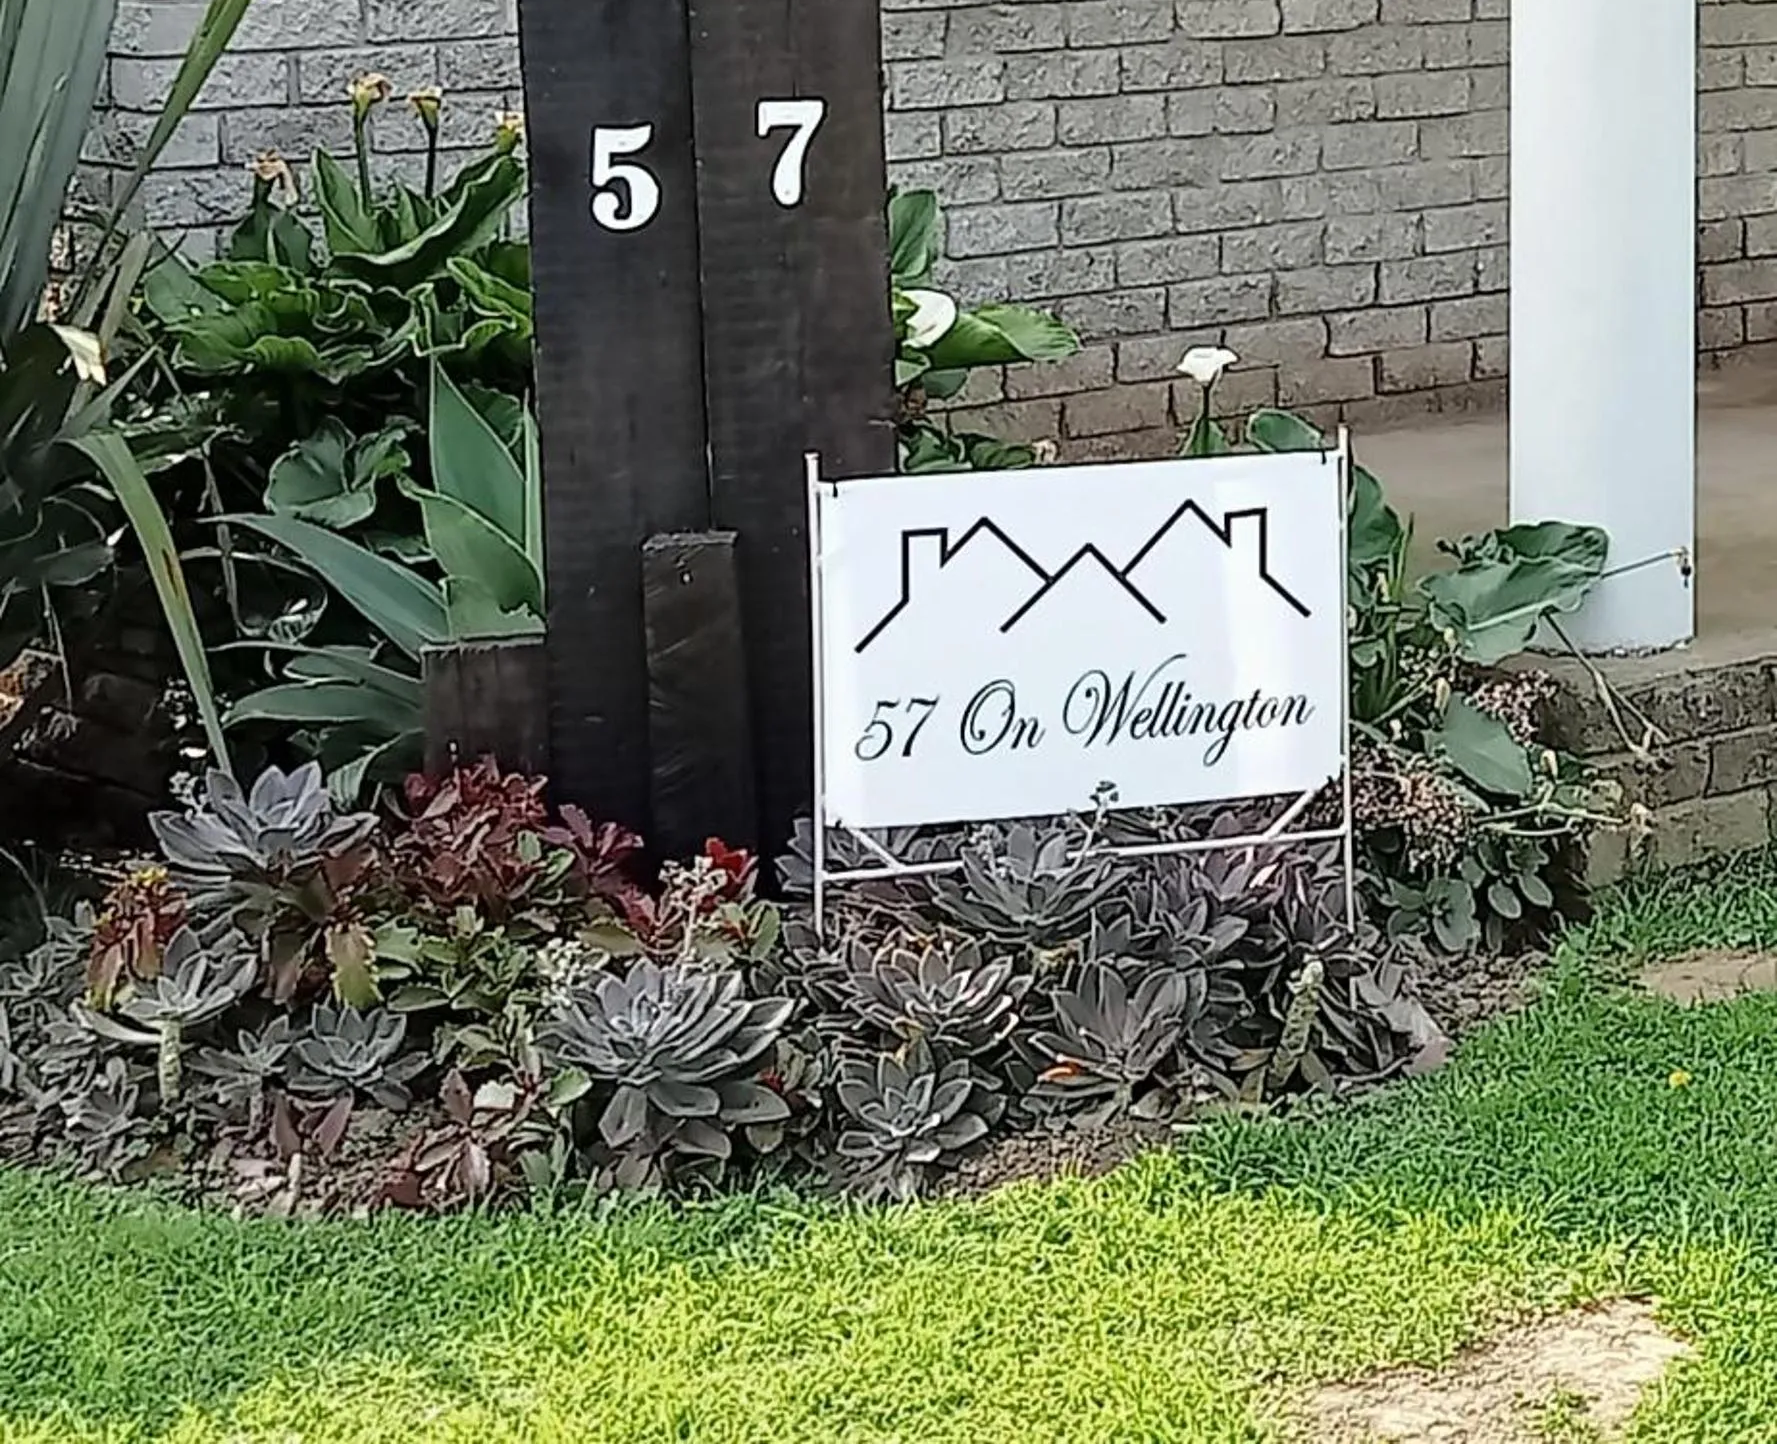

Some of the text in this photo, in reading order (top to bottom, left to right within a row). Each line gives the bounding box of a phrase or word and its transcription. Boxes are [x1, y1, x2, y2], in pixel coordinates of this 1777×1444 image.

[591, 98, 825, 231] 5 7
[854, 653, 1315, 767] 57 On Wellington
